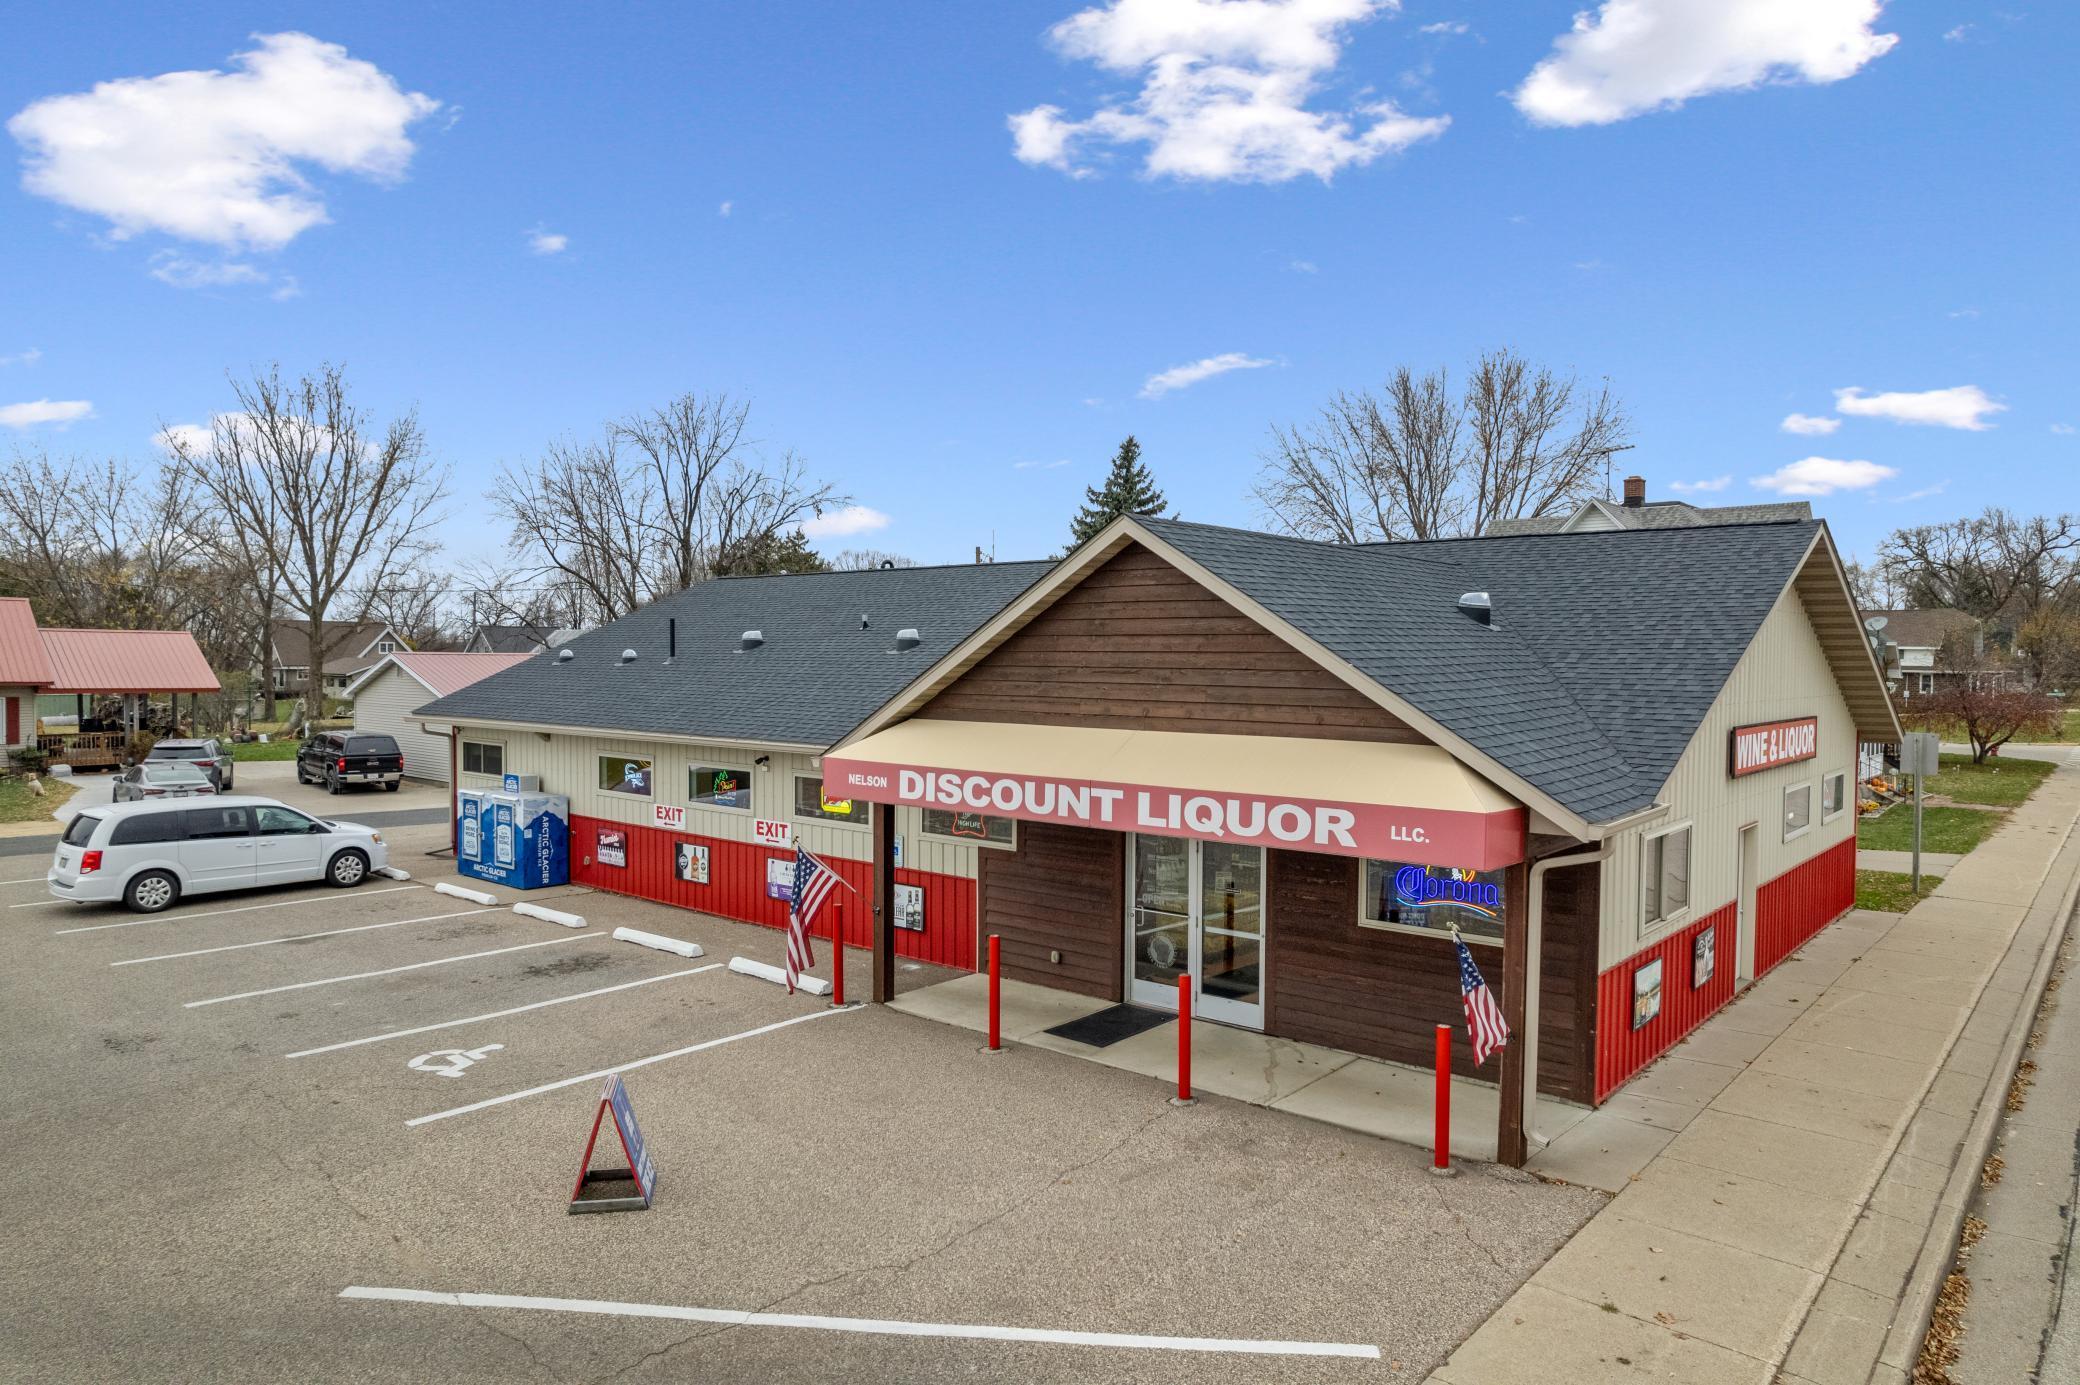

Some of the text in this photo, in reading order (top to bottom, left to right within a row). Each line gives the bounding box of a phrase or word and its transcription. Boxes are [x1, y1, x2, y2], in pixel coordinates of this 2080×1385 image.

[1737, 724, 1815, 770] WINE & LIQUOR
[656, 805, 684, 822] EXIT
[848, 769, 1430, 848] NELSON DISCOUNT LIQUOR LLC.
[756, 821, 788, 838] EXIT
[958, 819, 981, 829] HIGH LIFE
[542, 816, 550, 885] ARCTIC GLACIER
[474, 864, 506, 877] ARCTIC GLACIER
[1395, 866, 1499, 906] Corona
